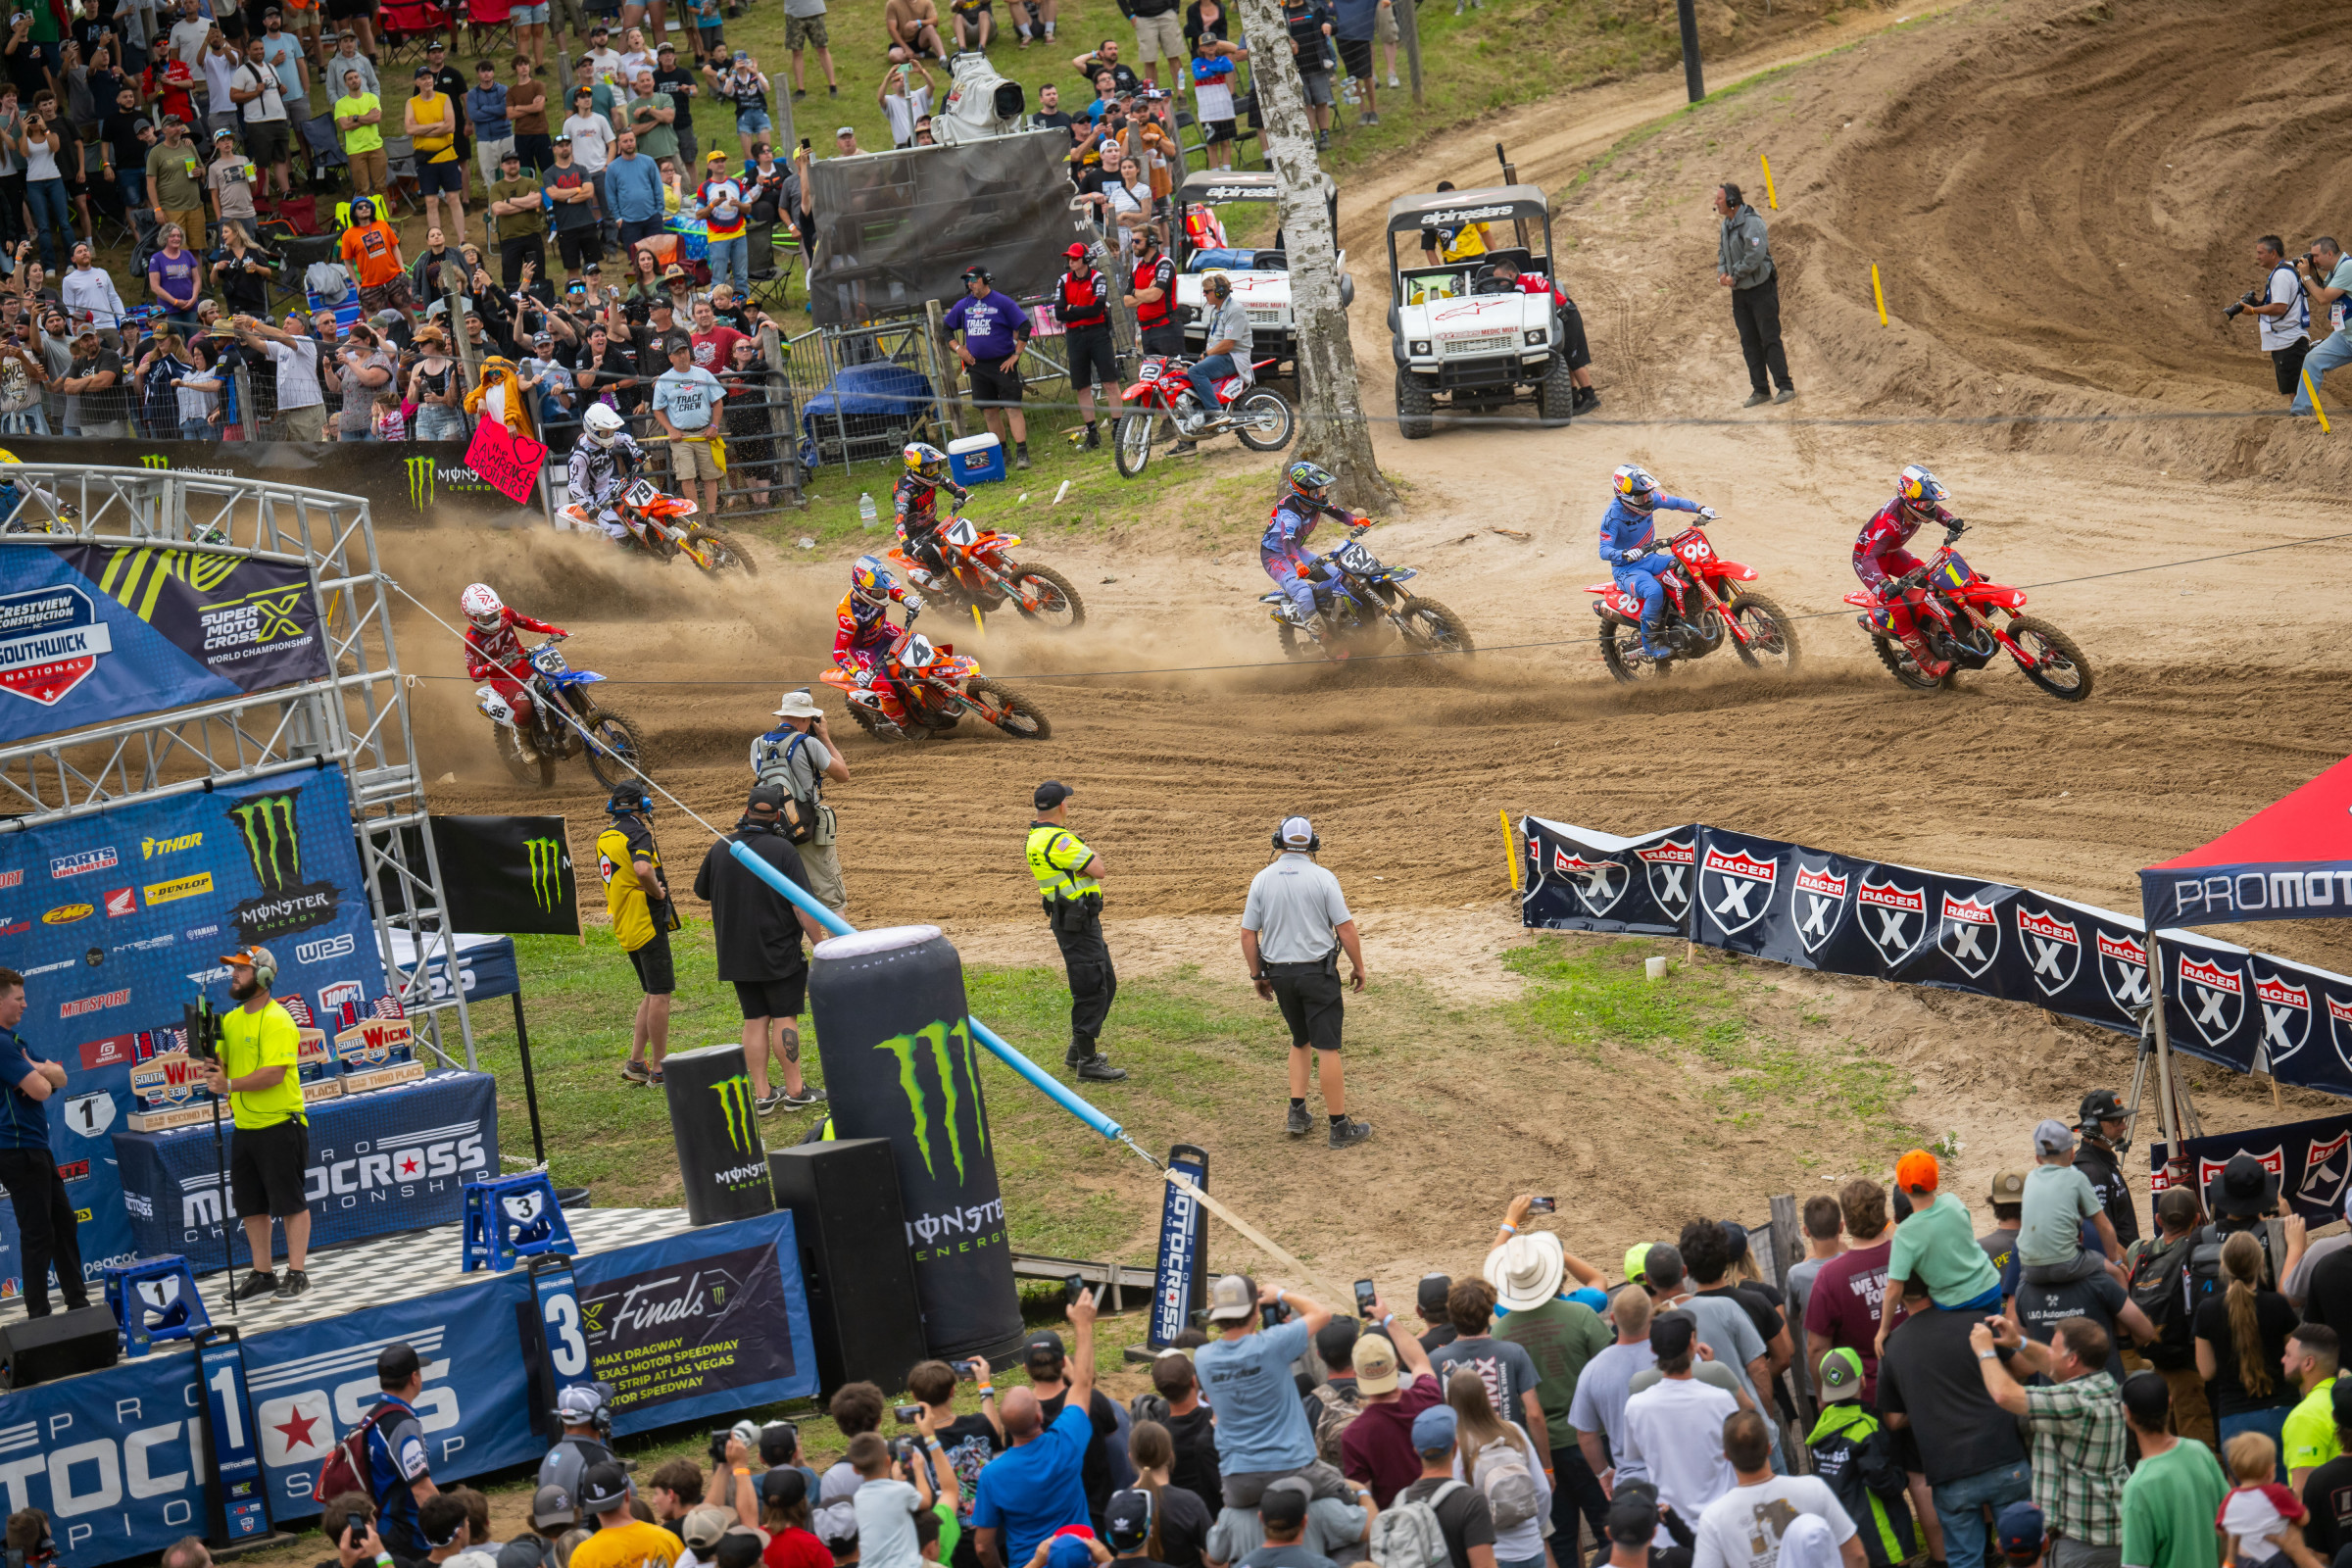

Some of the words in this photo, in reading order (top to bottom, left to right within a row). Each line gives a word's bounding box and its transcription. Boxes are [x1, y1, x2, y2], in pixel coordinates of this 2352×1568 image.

[1206, 186, 1276, 199] alpinesta
[1421, 205, 1514, 224] alpinestars
[966, 318, 992, 328] TRACK
[967, 326, 991, 336] MEDIC
[1481, 327, 1499, 336] MEDIC
[1141, 367, 1159, 380] 2
[676, 393, 703, 405] TRACK
[678, 402, 702, 413] CREW
[471, 434, 536, 483] LAWRENCE
[491, 442, 509, 457] the
[470, 454, 525, 499] BROTHERS
[630, 481, 652, 506] 79
[952, 521, 971, 546] 7
[1347, 544, 1373, 570] 32
[1684, 540, 1710, 564] 96
[1946, 562, 1964, 587] 1
[1618, 594, 1640, 613] 96
[201, 606, 259, 627] SUPER
[1725, 613, 1745, 638] DUNLOP
[207, 617, 259, 638] MOTO
[204, 629, 260, 650] CROSS
[208, 652, 241, 664] WORLD
[243, 636, 313, 658] CHAMPIONSHIP
[539, 652, 565, 672] 36
[912, 641, 931, 666] 4
[2002, 641, 2028, 663] DUNLOP
[6, 662, 84, 682] NATIONAL
[490, 705, 507, 718] 36
[864, 696, 880, 709] 4
[156, 833, 203, 856] THOR
[52, 849, 116, 870] PARTS
[1645, 851, 1693, 861] RACER
[53, 858, 118, 878] UNLIMITED
[1710, 857, 1771, 878] RACER
[158, 878, 209, 896] DUNLOP
[1661, 864, 1688, 904] X
[1799, 875, 1843, 895] RACER
[1714, 875, 1756, 919] X
[1862, 890, 1919, 908] RACER
[50, 906, 93, 922] FMF
[109, 907, 136, 917] HONDA
[242, 893, 329, 923] MONSTER
[1801, 895, 1833, 936] X
[1946, 905, 1991, 922] RACER
[194, 925, 219, 936] YAMAHA
[257, 912, 317, 931] ENERGY
[1878, 907, 1909, 951] X
[2023, 916, 2075, 942] RACER
[298, 936, 353, 962] WPS
[1954, 922, 1987, 961] X
[2033, 936, 2065, 981] X
[2102, 943, 2146, 963] RACE
[20, 959, 75, 976] LANDMASTER
[2183, 965, 2237, 991] RACER
[2115, 960, 2146, 1004] X
[324, 986, 359, 1006] 100%
[2258, 987, 2305, 1005] ACER
[2195, 985, 2229, 1031] X
[2262, 1004, 2293, 1049] X
[338, 1037, 366, 1051] SOUTH
[363, 1026, 411, 1050] WICK
[96, 1054, 122, 1063] GASGAS
[368, 1048, 386, 1059] 338
[134, 1072, 165, 1085] SOUTH
[165, 1062, 204, 1086] WIC
[368, 1072, 394, 1086] THIRD
[396, 1066, 423, 1080] PLACE
[169, 1087, 188, 1098] 338
[305, 1084, 339, 1099] PLACE
[168, 1110, 201, 1124] SECOND
[516, 1197, 534, 1218] 3
[153, 1282, 166, 1306] 1
[537, 1278, 574, 1290] MOTOCROSS
[612, 1272, 704, 1341] Finals
[2042, 1311, 2085, 1322] Automotive
[545, 1294, 587, 1376] 3
[594, 1351, 621, 1368] MAX
[625, 1337, 683, 1360] DRAGWAY
[632, 1354, 672, 1372] MOTOR
[674, 1339, 739, 1362] SPEEDWAY
[618, 1373, 652, 1392] STRIP
[654, 1369, 667, 1383] AT
[670, 1365, 692, 1379] LAS
[694, 1354, 735, 1372] VEGAS
[640, 1375, 704, 1400] SPEEDWAY
[210, 1366, 244, 1449] 1
[220, 1458, 257, 1471] MOTOCROSS
